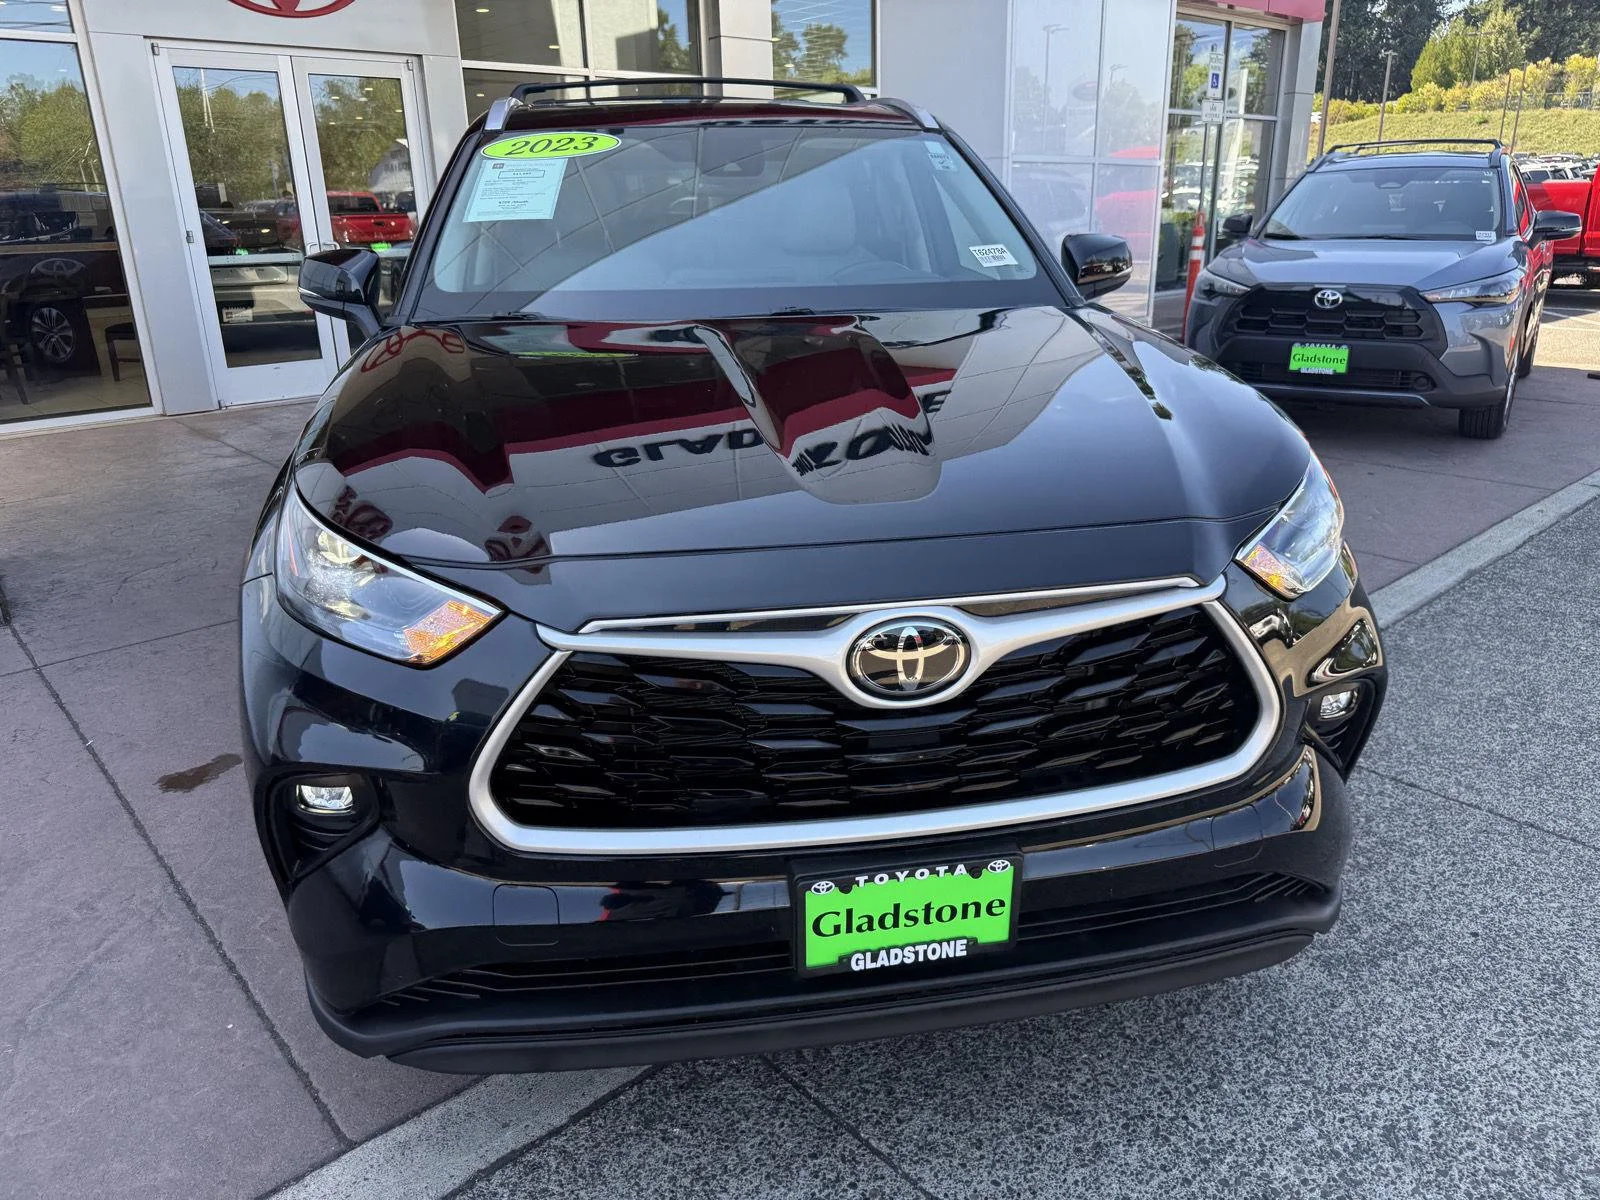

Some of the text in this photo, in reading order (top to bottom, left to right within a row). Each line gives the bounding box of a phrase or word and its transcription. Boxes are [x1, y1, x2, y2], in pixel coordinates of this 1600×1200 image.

[505, 136, 599, 156] 2023
[1293, 353, 1346, 365] Gladstone
[855, 864, 967, 888] TOYOTA
[811, 897, 1006, 938] Gladstone
[850, 938, 968, 972] GLADSTONE
